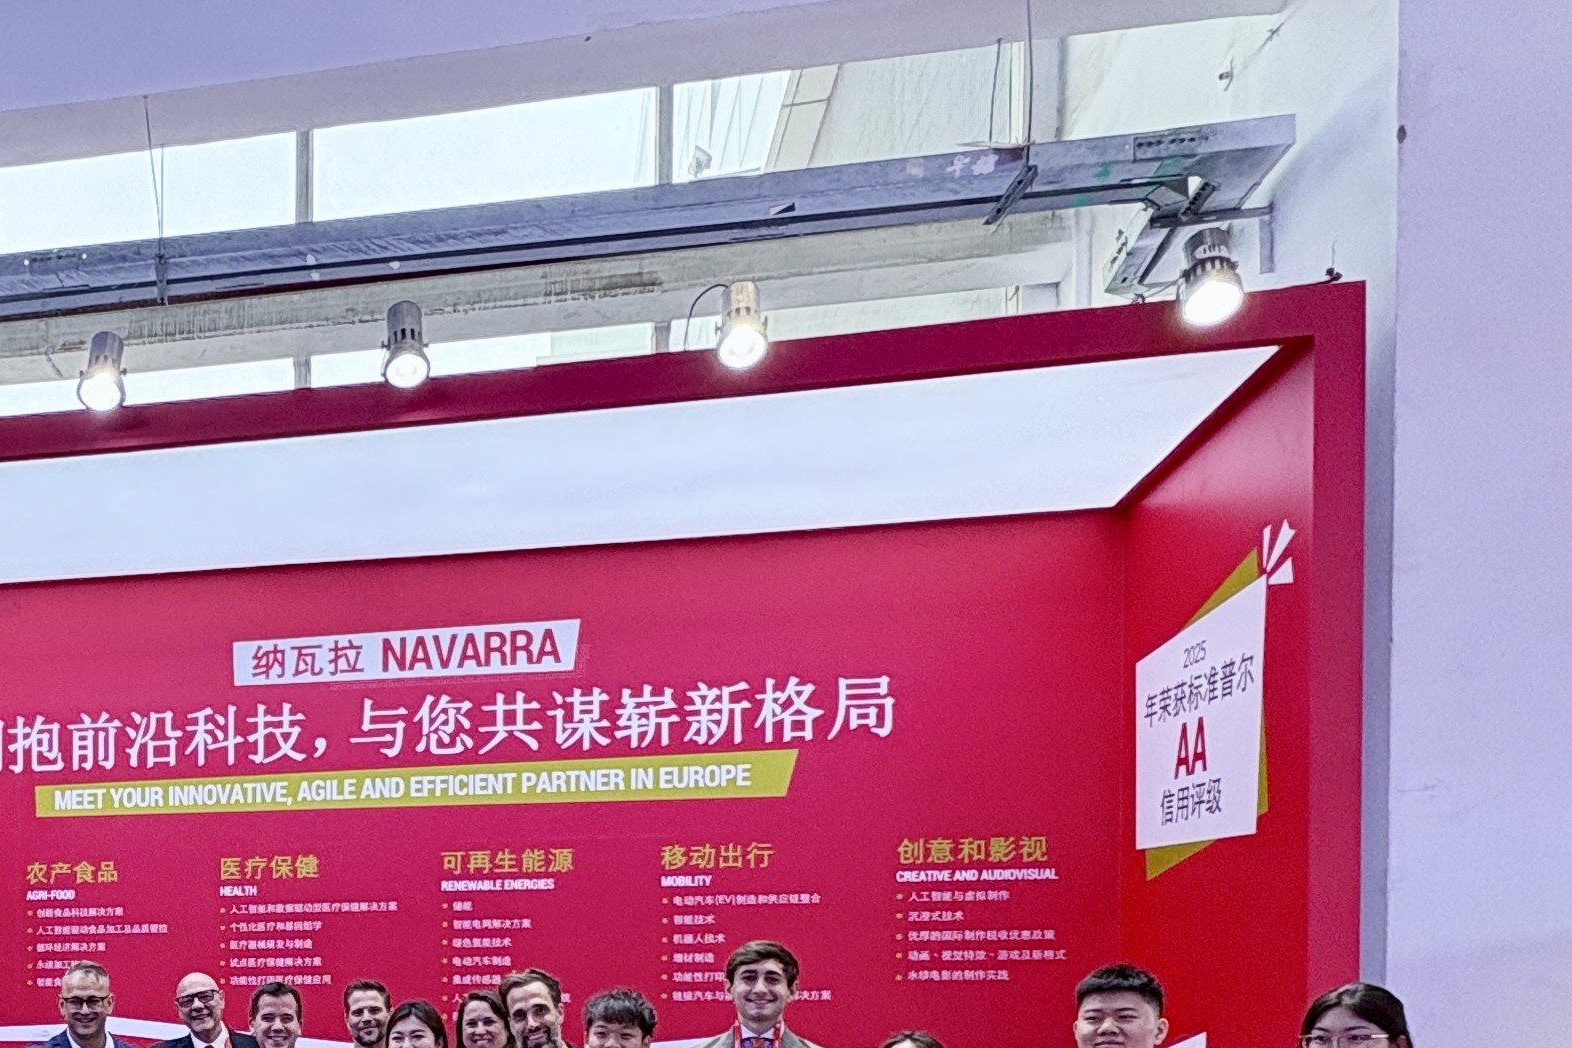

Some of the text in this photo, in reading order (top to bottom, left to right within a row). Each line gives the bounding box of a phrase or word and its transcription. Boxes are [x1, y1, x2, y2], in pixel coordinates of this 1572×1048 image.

[251, 628, 562, 680] 纳瓦拉 NAVARRA
[1182, 639, 1207, 669] 2025
[1143, 652, 1255, 728] 年荣获标准普尔
[1173, 715, 1208, 780] AA
[54, 763, 753, 811] MEET YOUR INNOVATIVE, AGILE AND EFFICIENT PARTNER IN EUROPE
[1160, 777, 1222, 826] 信用评级
[440, 848, 575, 875] 可再生能源
[660, 841, 775, 870] 移动出行
[896, 835, 1049, 865] 创意和影视
[26, 861, 118, 885] 农产食品
[220, 854, 320, 880] 医疗保健
[660, 874, 713, 887] MOBILITY
[895, 868, 1059, 882] CREATIVE AND AUDIOVISUAL
[26, 890, 76, 901] AGRI-FOOD
[219, 885, 258, 897] HEALTH
[440, 877, 555, 891] RENEWABLE ENERGIES
